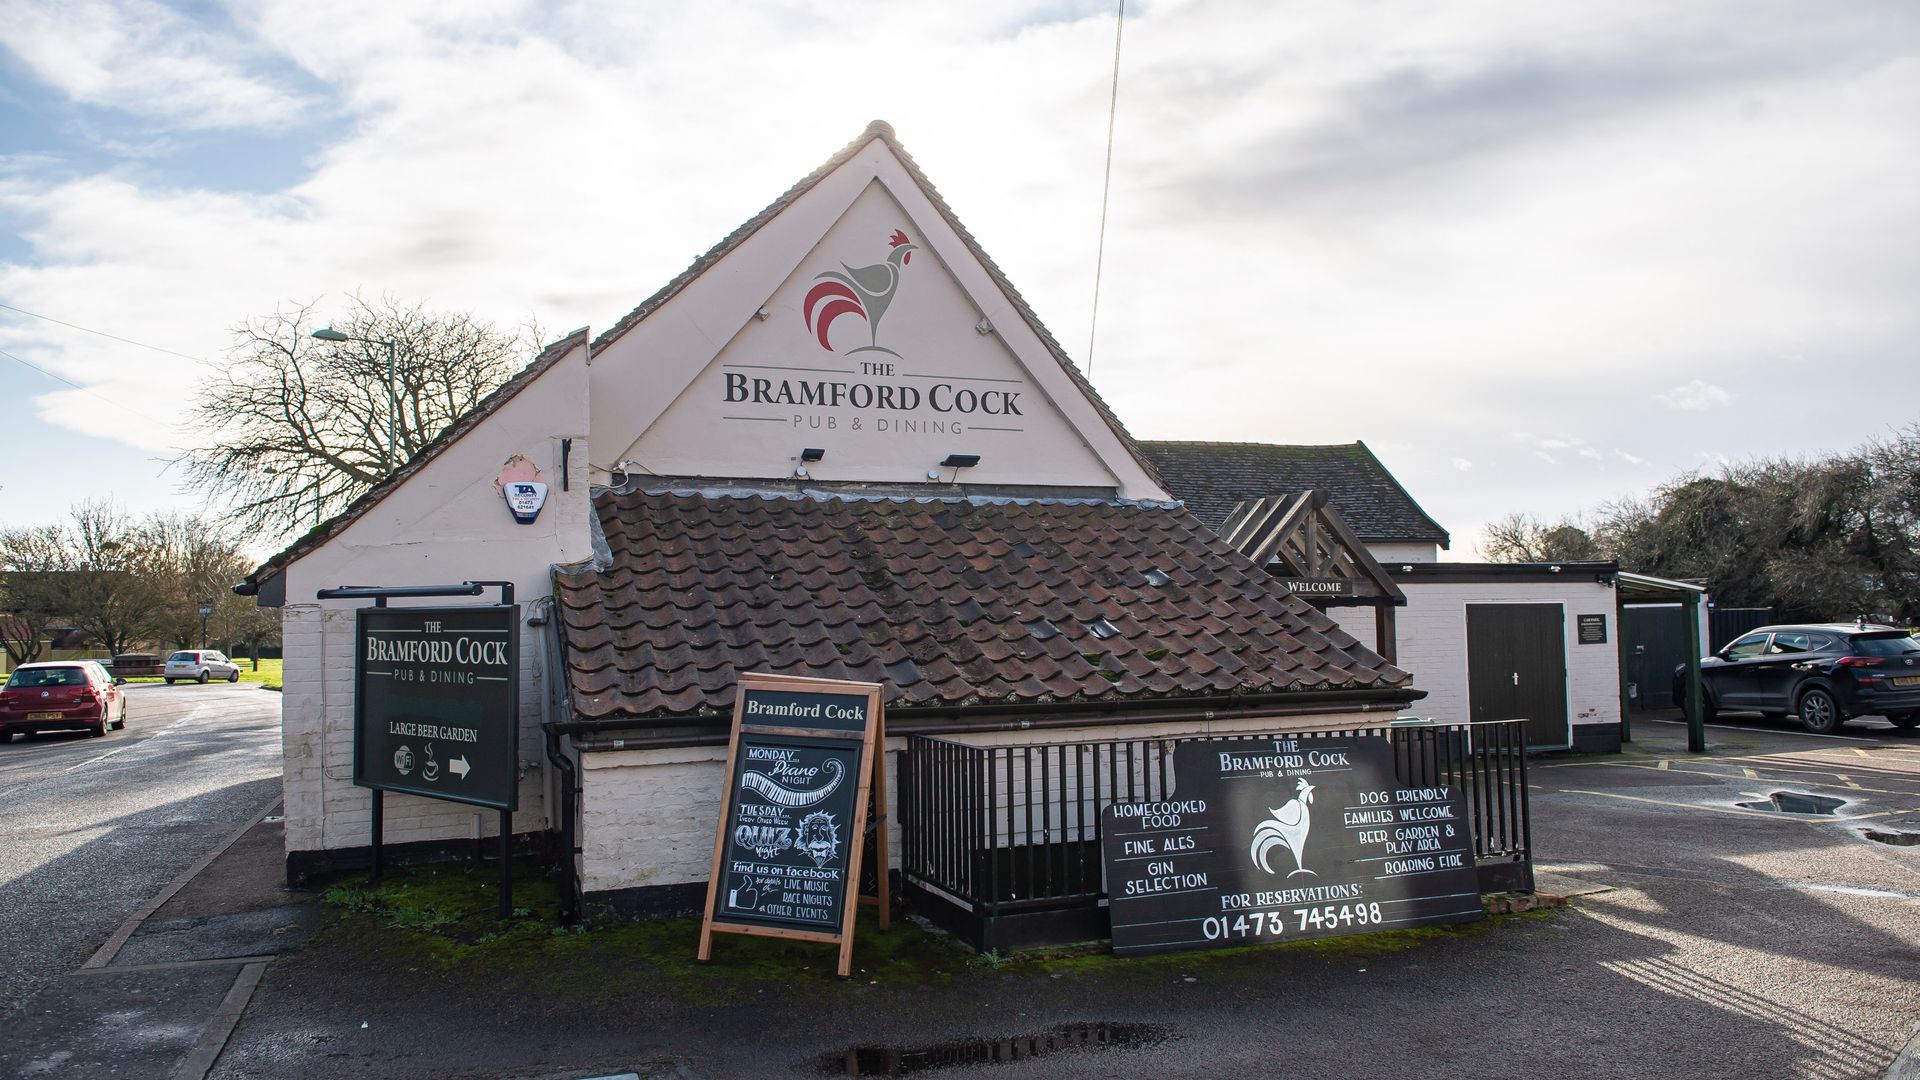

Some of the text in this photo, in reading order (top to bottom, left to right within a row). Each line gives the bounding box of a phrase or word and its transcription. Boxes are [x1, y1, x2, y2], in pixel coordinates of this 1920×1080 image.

[860, 362, 895, 377] THE
[723, 372, 1024, 416] BRAMFORD COCK
[793, 415, 963, 435] PUB & DINING
[1287, 581, 1342, 592] WELCOME
[424, 621, 441, 633] THE
[367, 637, 508, 665] BRAMFORD COCK
[394, 669, 474, 685] PUB & DINING
[747, 700, 864, 720] Bramford Cock
[390, 721, 478, 743] LARGE BEER GARDEN
[1272, 740, 1300, 753] THE
[768, 760, 819, 777] Piano
[1218, 751, 1350, 772] BRAMFORD COCK
[782, 776, 813, 785] NIGHT
[1260, 770, 1274, 778] PUB
[1287, 768, 1312, 777] DINING
[1360, 787, 1449, 805] DOG FRIENDLY
[1113, 800, 1206, 818] HOMECOOKED
[1344, 805, 1454, 826] FAMILIES WELCOME
[1142, 814, 1181, 829] FOOD
[735, 825, 793, 850] QUIZ
[1359, 824, 1455, 845] BEER GARDEN &
[1124, 835, 1195, 855] FINE ALES
[1386, 838, 1441, 854] PLAY AREA
[756, 865, 769, 874] us
[771, 867, 783, 875] on
[1147, 861, 1174, 876] GIN
[1385, 853, 1463, 875] ROARING FIRE
[784, 878, 830, 892] LIVE MUSIC
[1125, 872, 1208, 895] SELECTION
[783, 892, 833, 907] RACE NIGHTS
[1221, 883, 1363, 909] FOR RESERVATIONS:
[767, 905, 792, 917] OTHER
[796, 907, 828, 920] EVENTS
[1202, 902, 1382, 940] 01473 745498
